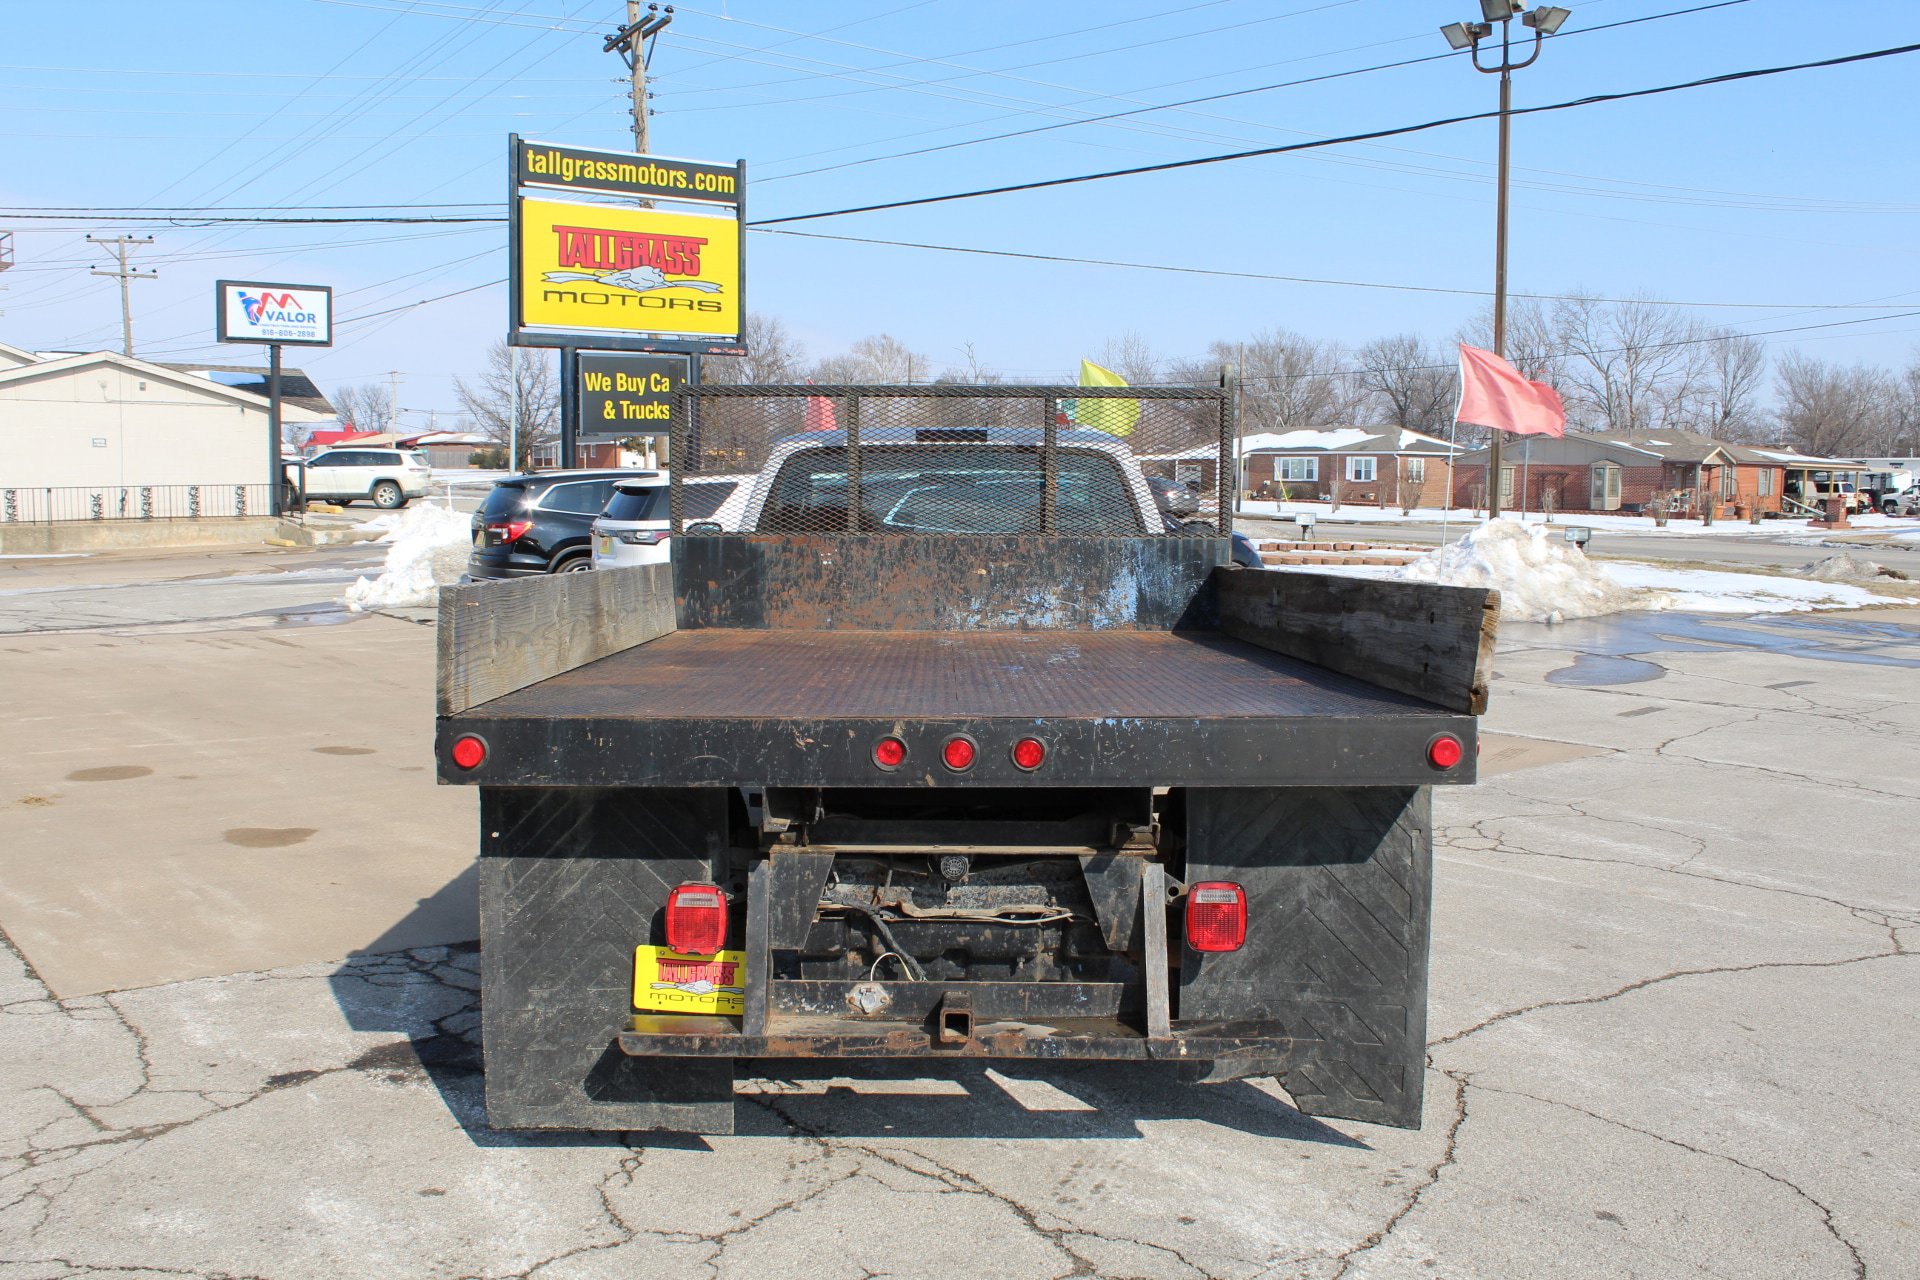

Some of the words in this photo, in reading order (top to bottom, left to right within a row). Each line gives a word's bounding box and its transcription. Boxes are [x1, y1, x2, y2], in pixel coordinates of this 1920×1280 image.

[527, 149, 735, 194] tallgrassmotors.com
[552, 224, 709, 276] TALLGRASS
[265, 310, 316, 324] VALOR
[584, 372, 612, 392] We
[616, 372, 646, 396] Buy
[603, 399, 616, 420] &
[619, 400, 670, 420] Trucks
[656, 958, 739, 986] TALLGRASS
